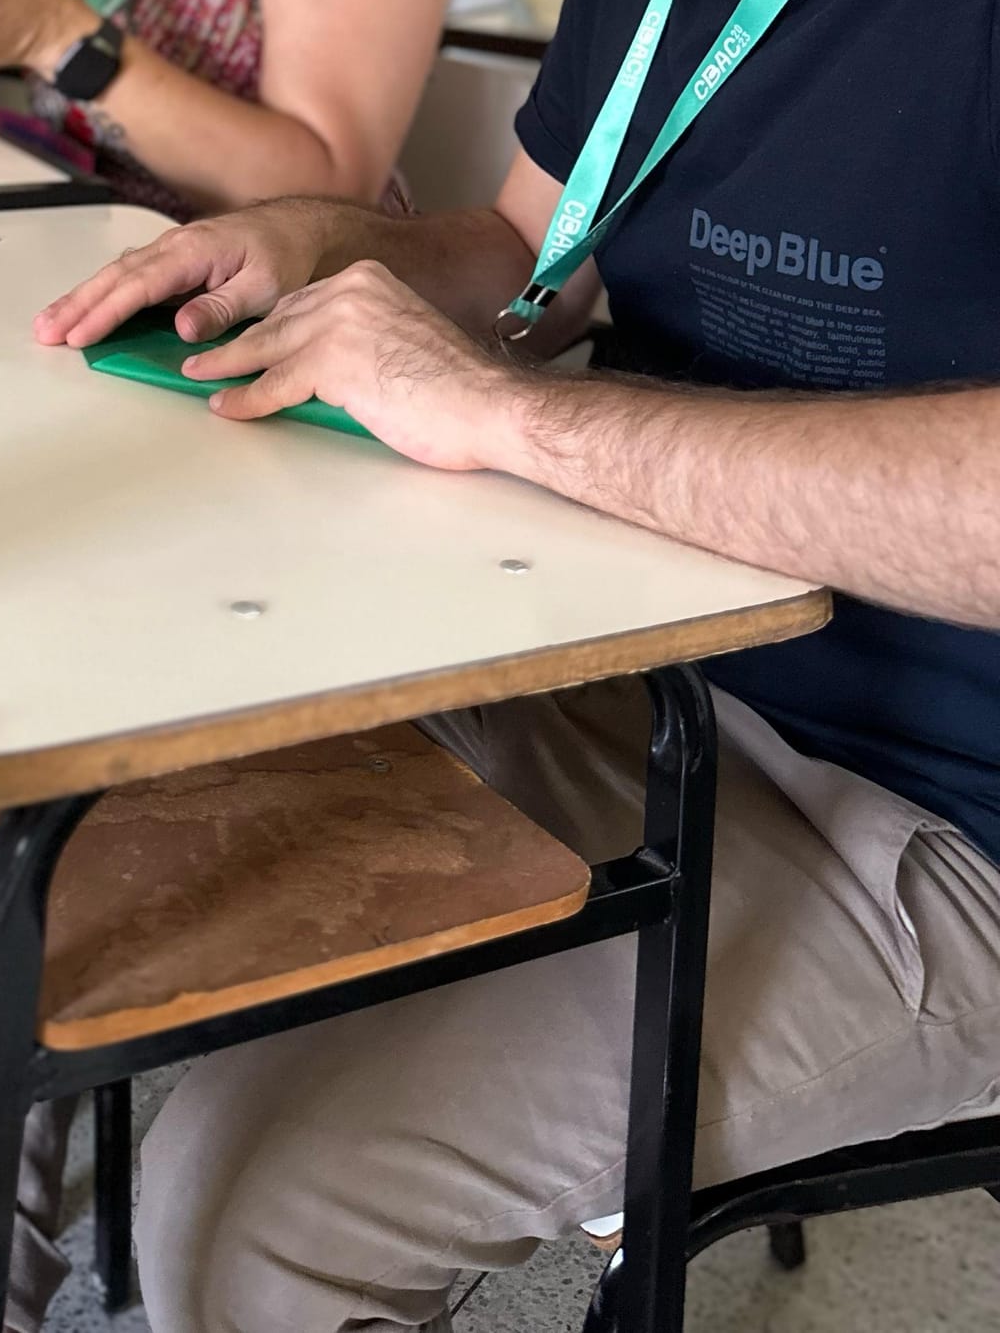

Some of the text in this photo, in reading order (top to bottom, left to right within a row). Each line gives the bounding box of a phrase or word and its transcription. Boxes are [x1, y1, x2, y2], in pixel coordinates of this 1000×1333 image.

[730, 24, 743, 39] 20
[738, 31, 751, 47] 23
[816, 301, 833, 310] THE
[835, 305, 860, 314] DEEP
[837, 321, 852, 331] the
[855, 325, 885, 334] colour
[806, 351, 851, 365] European
